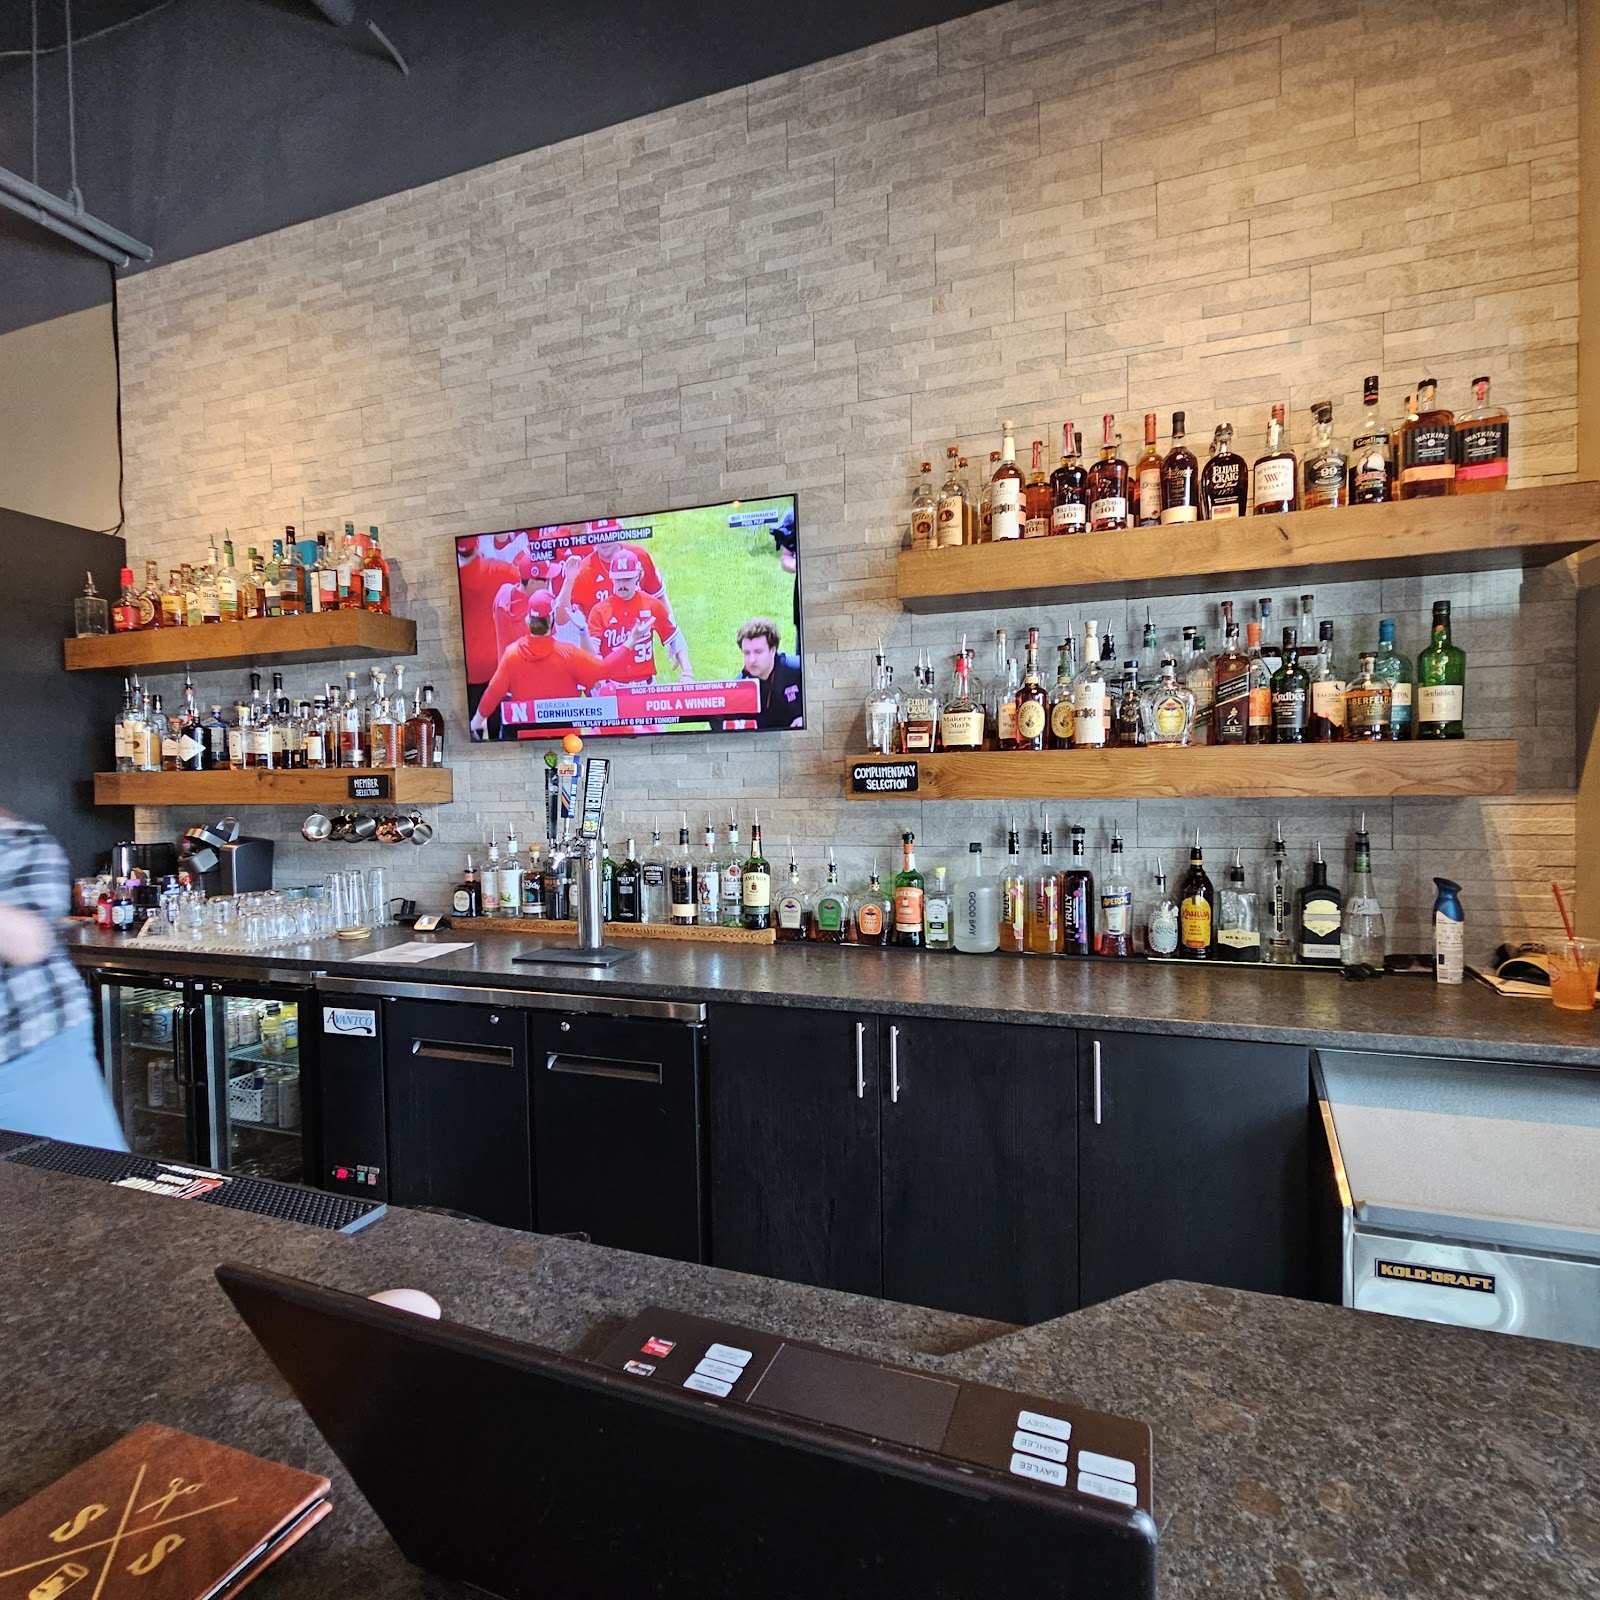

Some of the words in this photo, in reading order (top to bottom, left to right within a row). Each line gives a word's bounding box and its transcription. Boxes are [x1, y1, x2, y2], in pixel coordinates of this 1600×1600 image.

[1414, 432, 1450, 443] WATKINS
[1464, 430, 1502, 443] WATKINS
[1212, 464, 1239, 475] ELIJAH
[1257, 464, 1290, 476] WYOMING
[1320, 466, 1338, 477] 99
[1211, 472, 1239, 484] CRAIG
[1100, 506, 1115, 514] 101
[914, 512, 934, 521] Tito's
[1062, 512, 1077, 520] 101
[530, 541, 540, 551] TO
[542, 539, 556, 550] GET
[558, 538, 569, 548] TO
[570, 535, 587, 546] THE
[588, 528, 651, 544] CHAMPIONSHIP
[530, 550, 555, 561] GAME.
[695, 683, 724, 691] SEMIFINAL
[907, 698, 929, 706] ELIJAH
[1272, 691, 1306, 704] Ardbeg
[536, 701, 570, 710] NEBRASKA
[646, 700, 673, 712] POOL
[675, 699, 683, 710] A
[684, 697, 726, 709] WINNER
[907, 705, 929, 714] CRAIG
[510, 702, 528, 722] N
[537, 708, 603, 719] CORNHUSKERS
[654, 716, 680, 724] TONIGHT
[943, 714, 972, 723] Maker's
[950, 721, 971, 729] Mark
[854, 765, 916, 780] COMPLIMENTARY
[353, 778, 379, 788] MEMBER
[866, 778, 908, 790] SELECTION
[355, 788, 380, 797] SELECTION
[968, 891, 977, 918] GOOD
[1103, 895, 1129, 906] APEROL
[1003, 891, 1011, 923] TRULY
[1036, 893, 1045, 925] TRULY
[1065, 893, 1074, 927] TRULY
[326, 1010, 373, 1029] AVANTCO
[1381, 1264, 1492, 1290] KOLD-DRAFT
[1020, 1438, 1061, 1455] ASHLEE
[1019, 1461, 1060, 1479] BAYLEE
